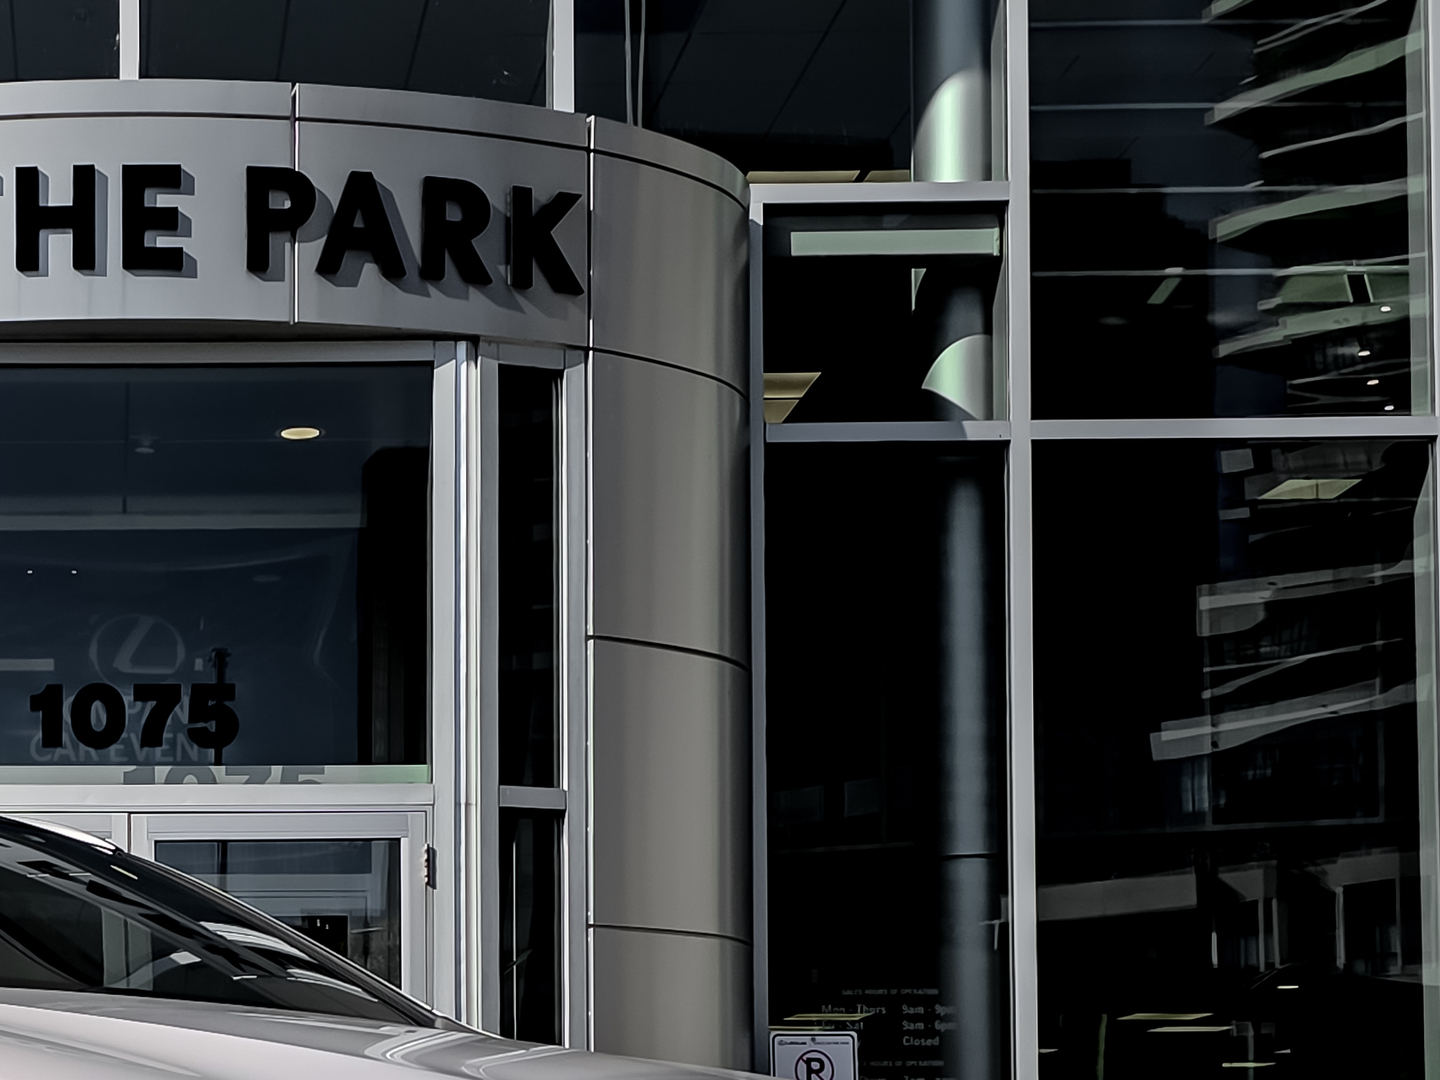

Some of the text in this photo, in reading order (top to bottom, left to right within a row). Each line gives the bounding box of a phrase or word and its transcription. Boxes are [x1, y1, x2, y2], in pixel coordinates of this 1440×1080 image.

[246, 164, 585, 296] PARK
[30, 682, 240, 749] 1075
[29, 732, 100, 762] CAR
[901, 1003, 925, 1015] 9am
[902, 1035, 940, 1047] Closed
